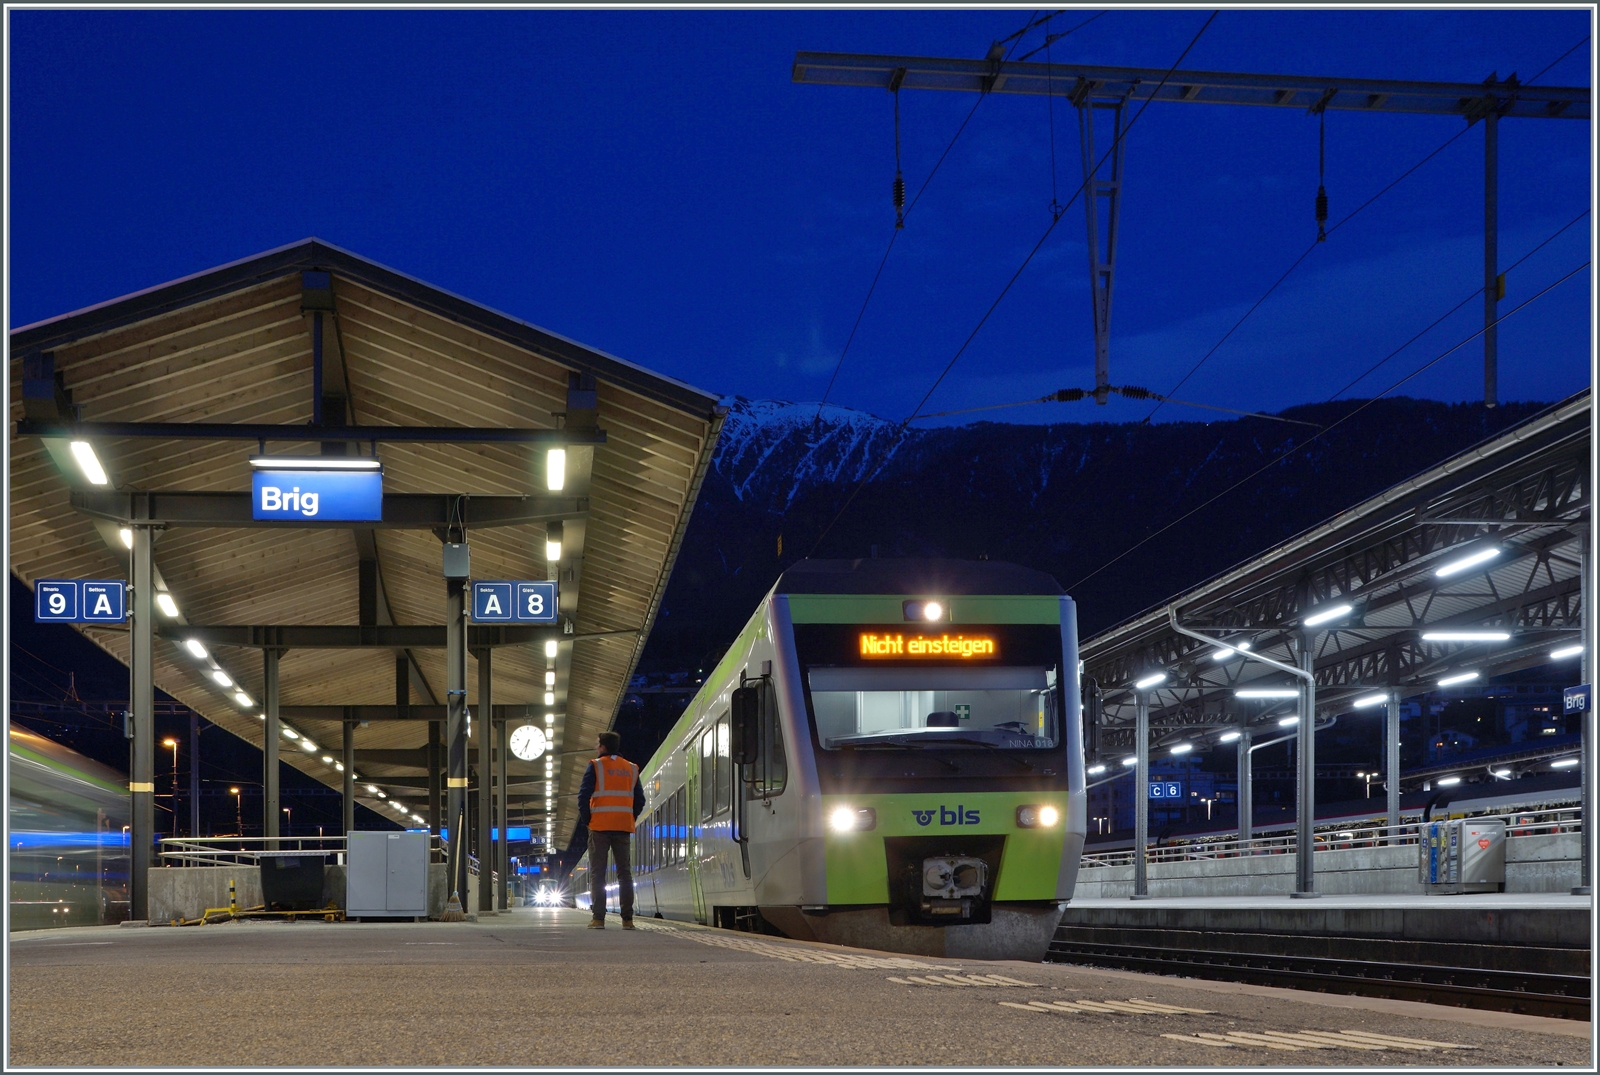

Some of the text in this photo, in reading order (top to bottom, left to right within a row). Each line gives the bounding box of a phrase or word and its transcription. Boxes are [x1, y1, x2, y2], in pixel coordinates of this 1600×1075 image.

[261, 486, 319, 516] Brig
[48, 593, 66, 615] 9
[93, 593, 113, 615] A
[484, 594, 502, 615] A
[527, 593, 544, 615] 8
[861, 634, 994, 657] Nicht einsteigen
[1566, 696, 1585, 710] Brig
[1009, 739, 1054, 748] NINA 018
[1153, 786, 1161, 796] C
[1169, 786, 1177, 796] 6
[940, 805, 981, 826] bls
